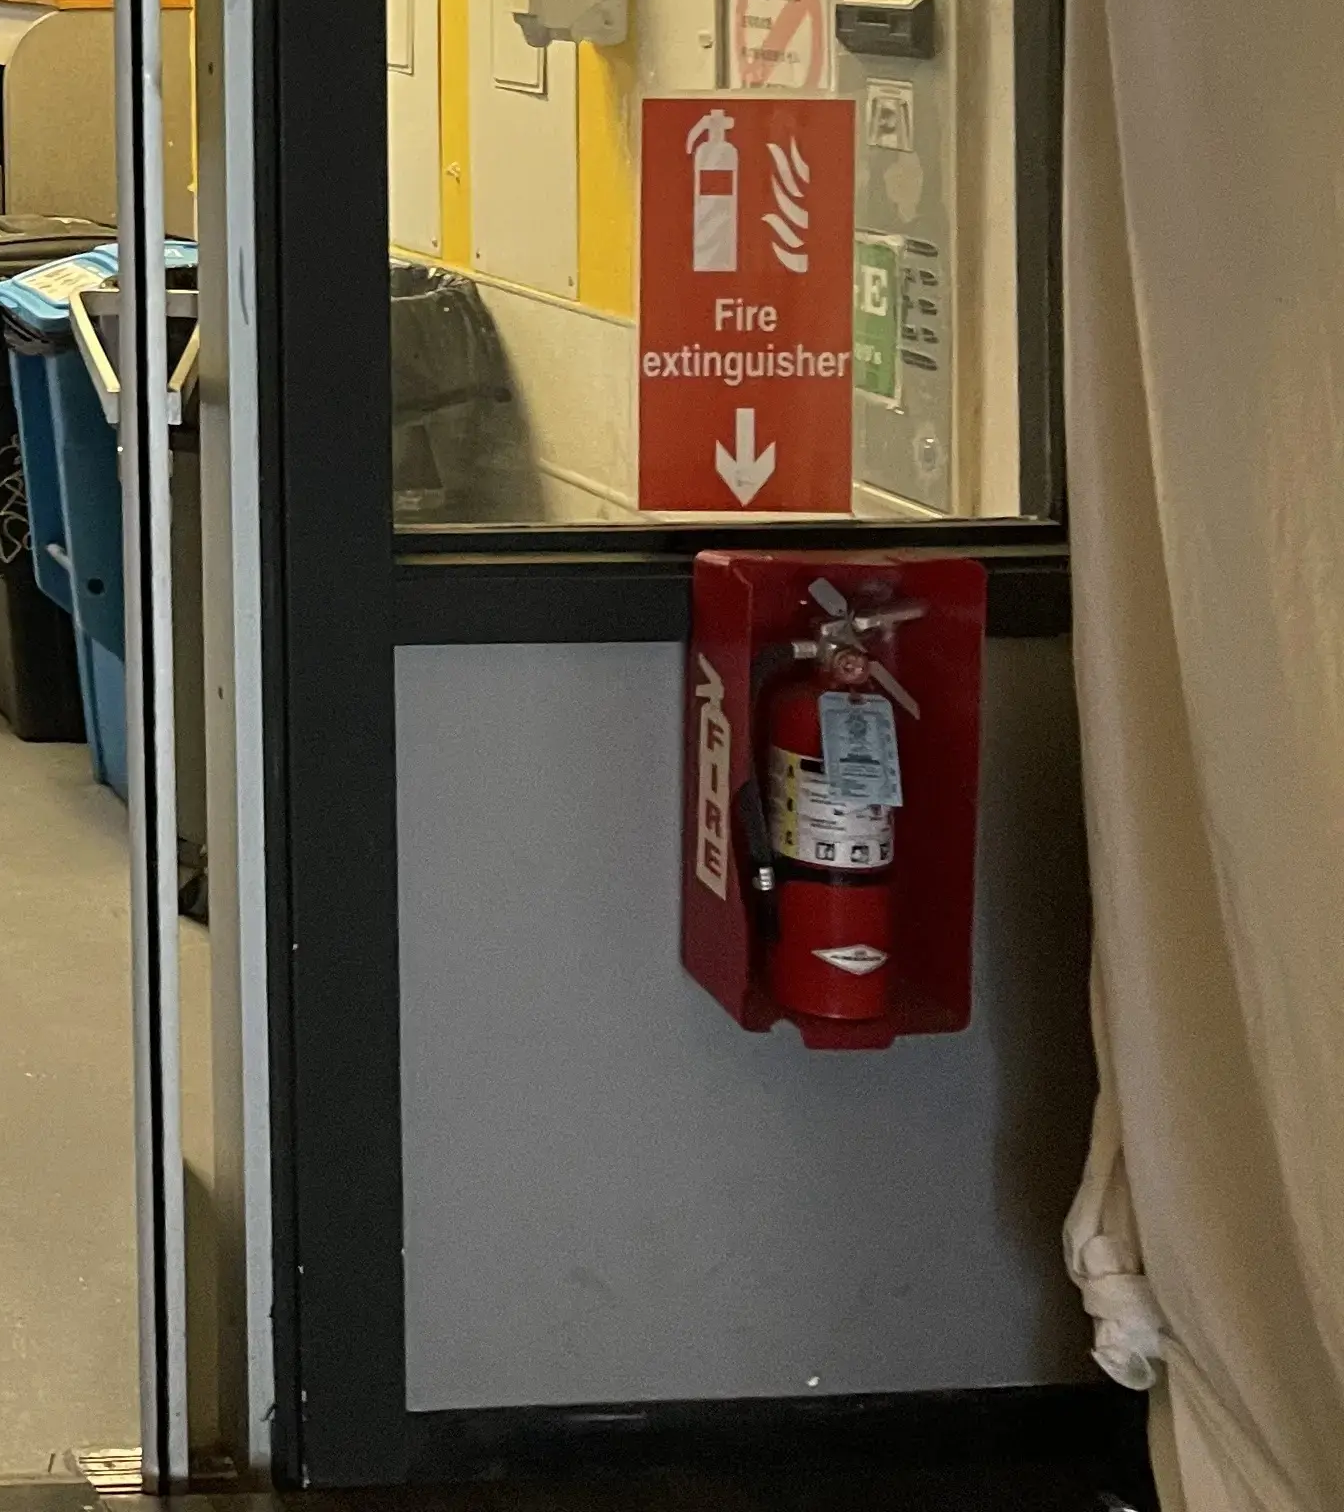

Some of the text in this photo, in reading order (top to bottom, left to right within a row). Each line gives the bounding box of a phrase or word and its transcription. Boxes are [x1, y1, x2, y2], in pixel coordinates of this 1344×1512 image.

[714, 297, 778, 333] Fire
[642, 343, 849, 387] extinguisher
[704, 717, 725, 879] FIRE
